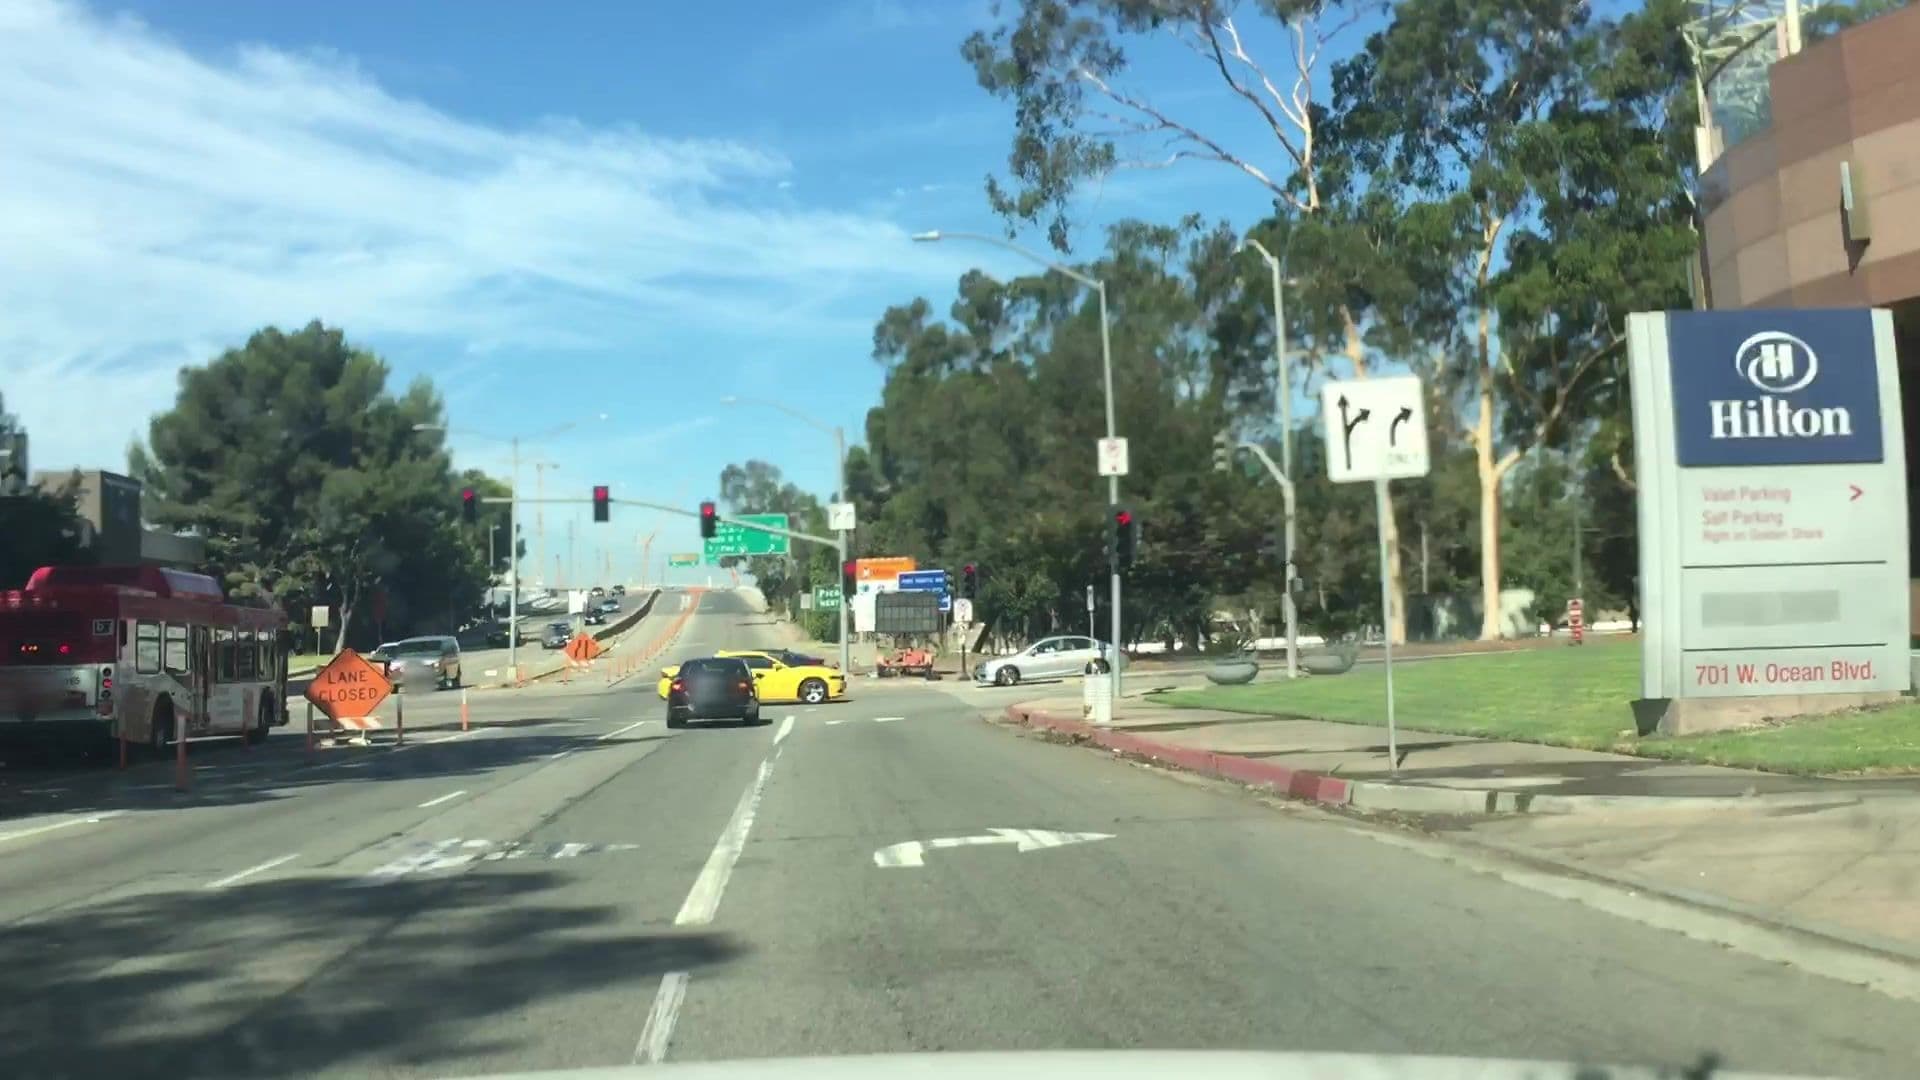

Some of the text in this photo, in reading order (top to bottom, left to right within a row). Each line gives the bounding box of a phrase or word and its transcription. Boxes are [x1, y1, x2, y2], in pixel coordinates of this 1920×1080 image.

[1709, 395, 1853, 439] Hilton
[1702, 486, 1791, 503] Valet Parking
[1702, 509, 1784, 526] Self Parking
[327, 670, 369, 685] LANE
[1695, 660, 1877, 686] 701 W. Ocean Blvd.
[318, 687, 378, 703] CLOSED
